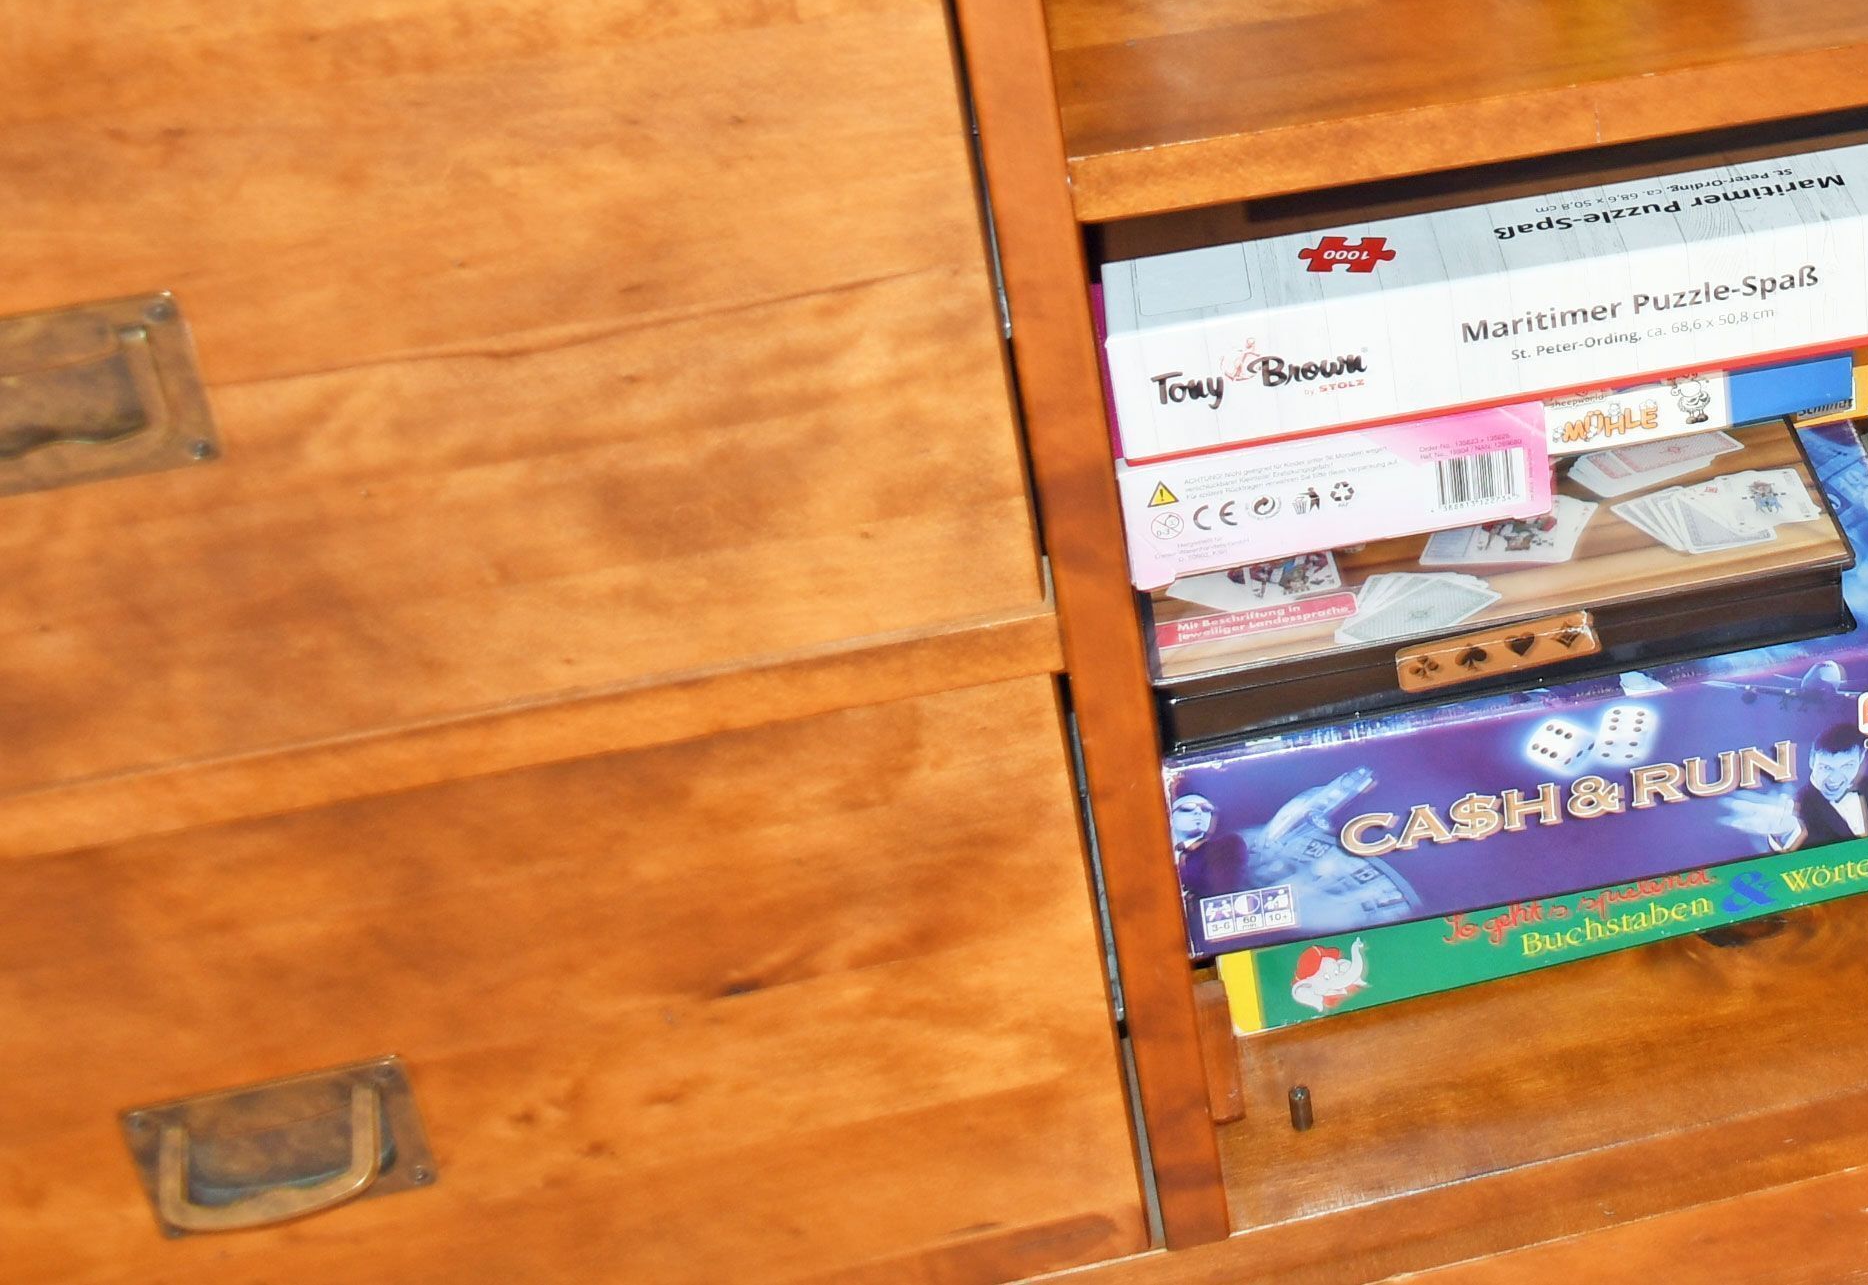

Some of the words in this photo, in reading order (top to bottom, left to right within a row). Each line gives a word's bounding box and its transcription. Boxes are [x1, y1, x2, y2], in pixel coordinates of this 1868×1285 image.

[1691, 173, 1845, 207] Maritimer
[1493, 199, 1681, 241] Puzzle-Spaß
[1322, 249, 1371, 261] 1000
[1461, 300, 1622, 344] Maritimer
[1632, 264, 1819, 315] Puzzle-Spaß
[1510, 347, 1532, 361] St.
[1535, 328, 1643, 358] Peter-Ording,
[1646, 326, 1668, 339] ca.
[1671, 317, 1702, 334] 68,6
[1705, 318, 1715, 328] x
[1718, 309, 1749, 327] 50,8
[1752, 307, 1775, 322] cm
[1151, 371, 1225, 410] Tony
[1247, 351, 1368, 387] Brown
[1319, 378, 1365, 393] STOLZ
[1562, 406, 1659, 444] MÜHLE
[1177, 622, 1199, 633] Mit
[1288, 604, 1301, 615] in
[1339, 782, 1563, 857] CA$H
[1567, 775, 1626, 819] &
[1630, 740, 1797, 808] RUN
[1212, 921, 1231, 932] 3-6
[1520, 893, 1711, 957] Buchstaben
[1721, 871, 1778, 914] &
